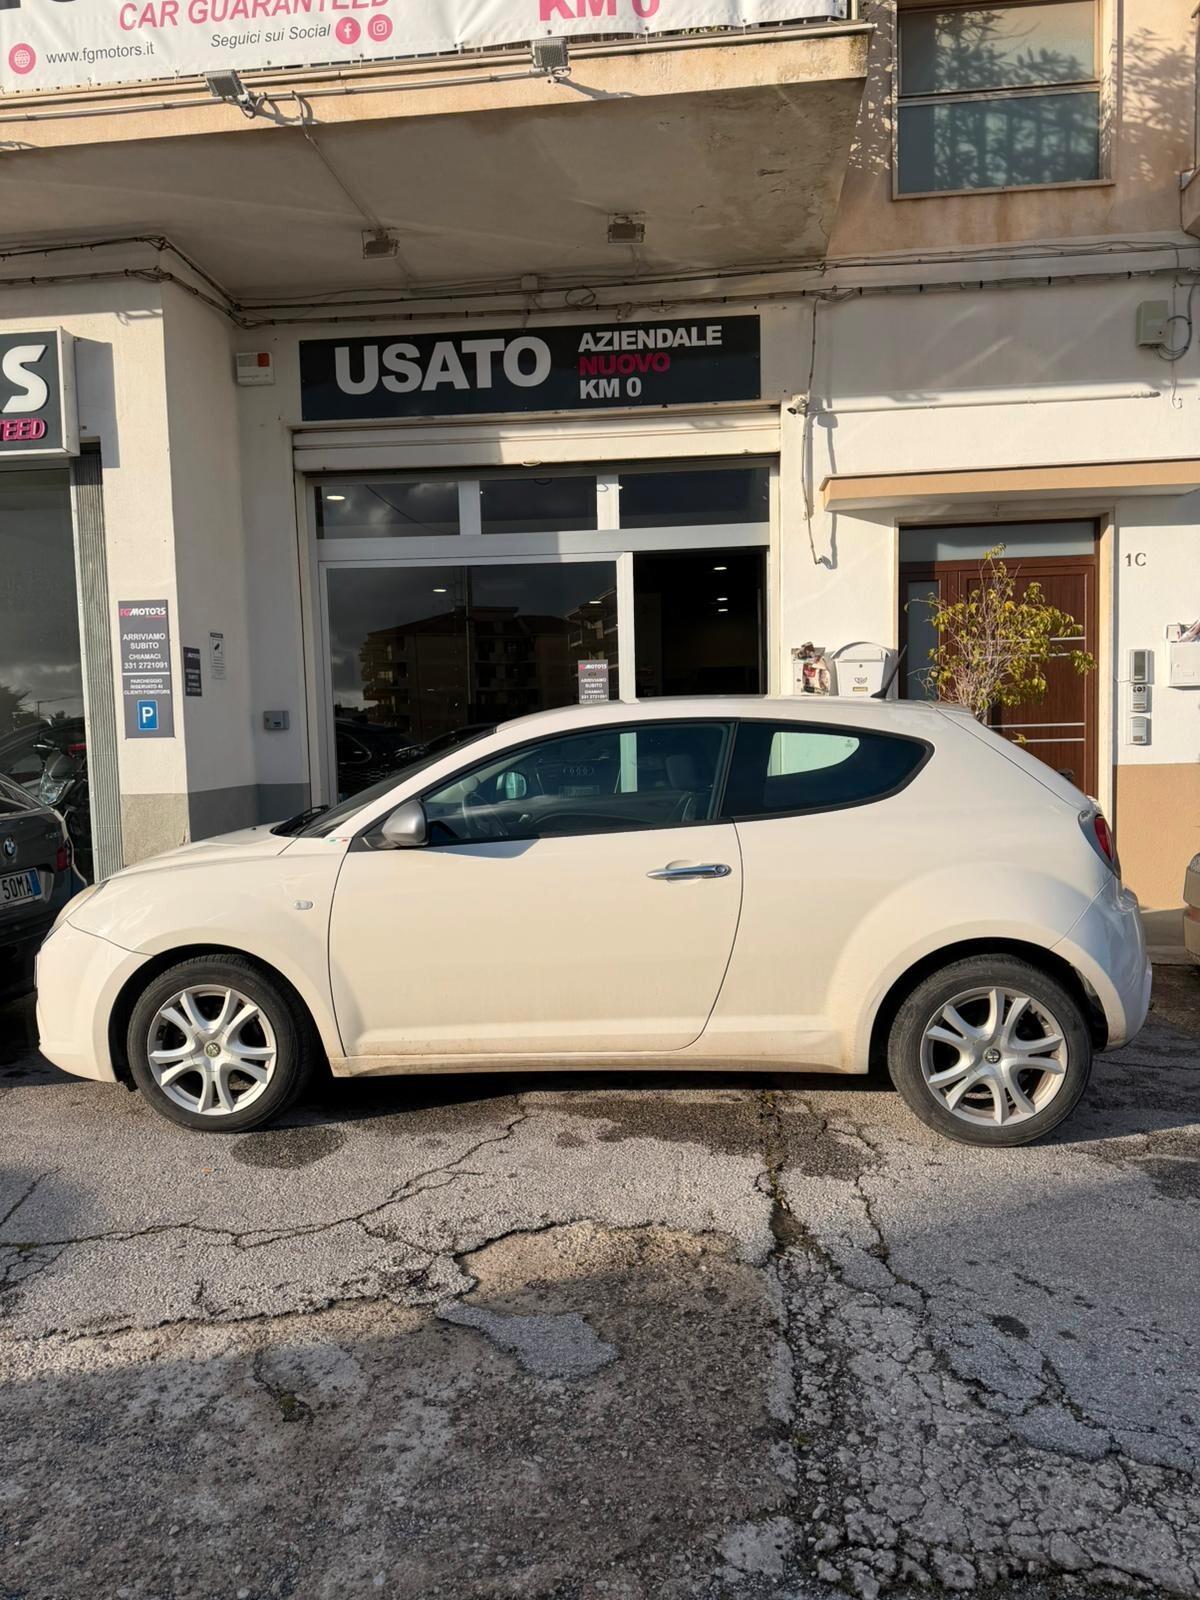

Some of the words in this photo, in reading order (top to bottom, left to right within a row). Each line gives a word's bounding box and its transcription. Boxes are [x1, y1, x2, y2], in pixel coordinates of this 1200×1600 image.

[119, 1, 179, 31] CAR
[188, 0, 389, 24] GUARAN
[211, 31, 261, 49] Seguici
[264, 28, 285, 43] sui
[289, 24, 331, 40] Social
[46, 41, 155, 64] www.fgmotors.it
[578, 325, 723, 353] AZIENDALE
[334, 336, 552, 395] USATO
[578, 351, 671, 376] NUOVO
[580, 377, 620, 399] KM
[626, 377, 642, 397] 0
[1124, 552, 1147, 567] 1C
[122, 632, 166, 641] ARRIVIAMO
[130, 641, 159, 649] SUBITO
[142, 706, 154, 724] P
